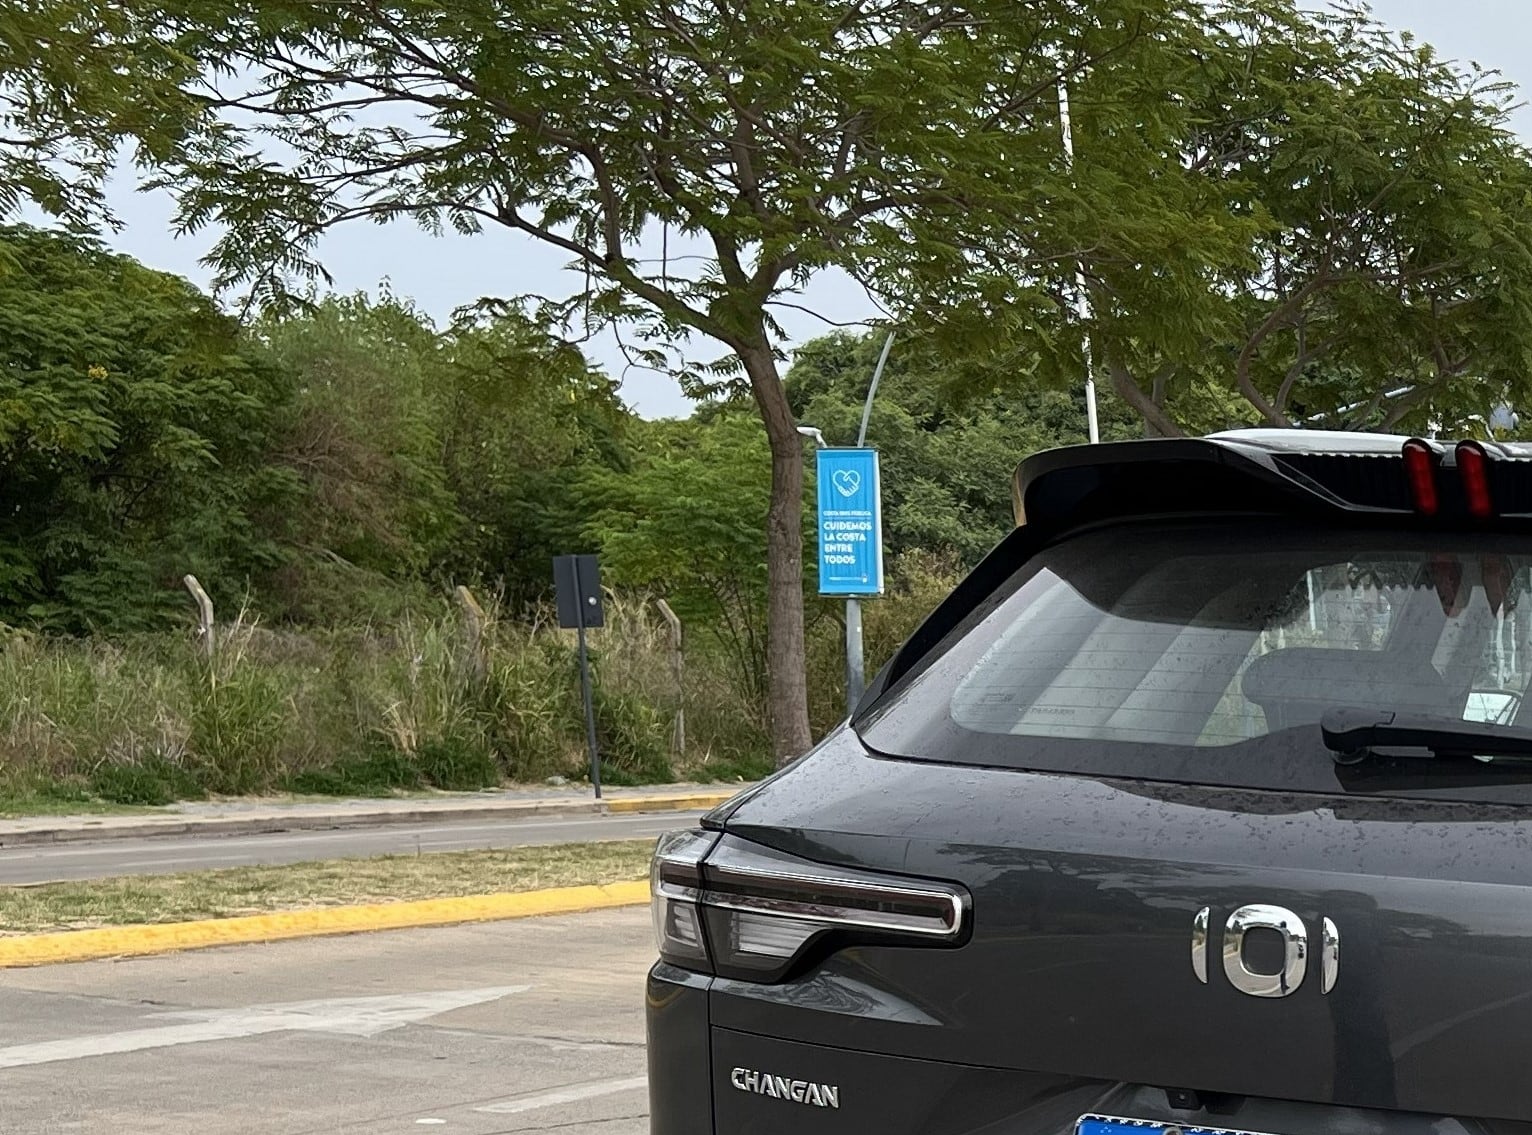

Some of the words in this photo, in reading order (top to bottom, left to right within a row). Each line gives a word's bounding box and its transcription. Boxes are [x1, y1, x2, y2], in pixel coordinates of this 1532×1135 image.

[823, 521, 872, 531] CUIDEMOS
[824, 532, 835, 541] LA
[836, 532, 866, 541] COSTA
[825, 543, 853, 552] ENTRE
[824, 554, 856, 564] TODOS
[731, 1067, 840, 1109] CHANGAN
